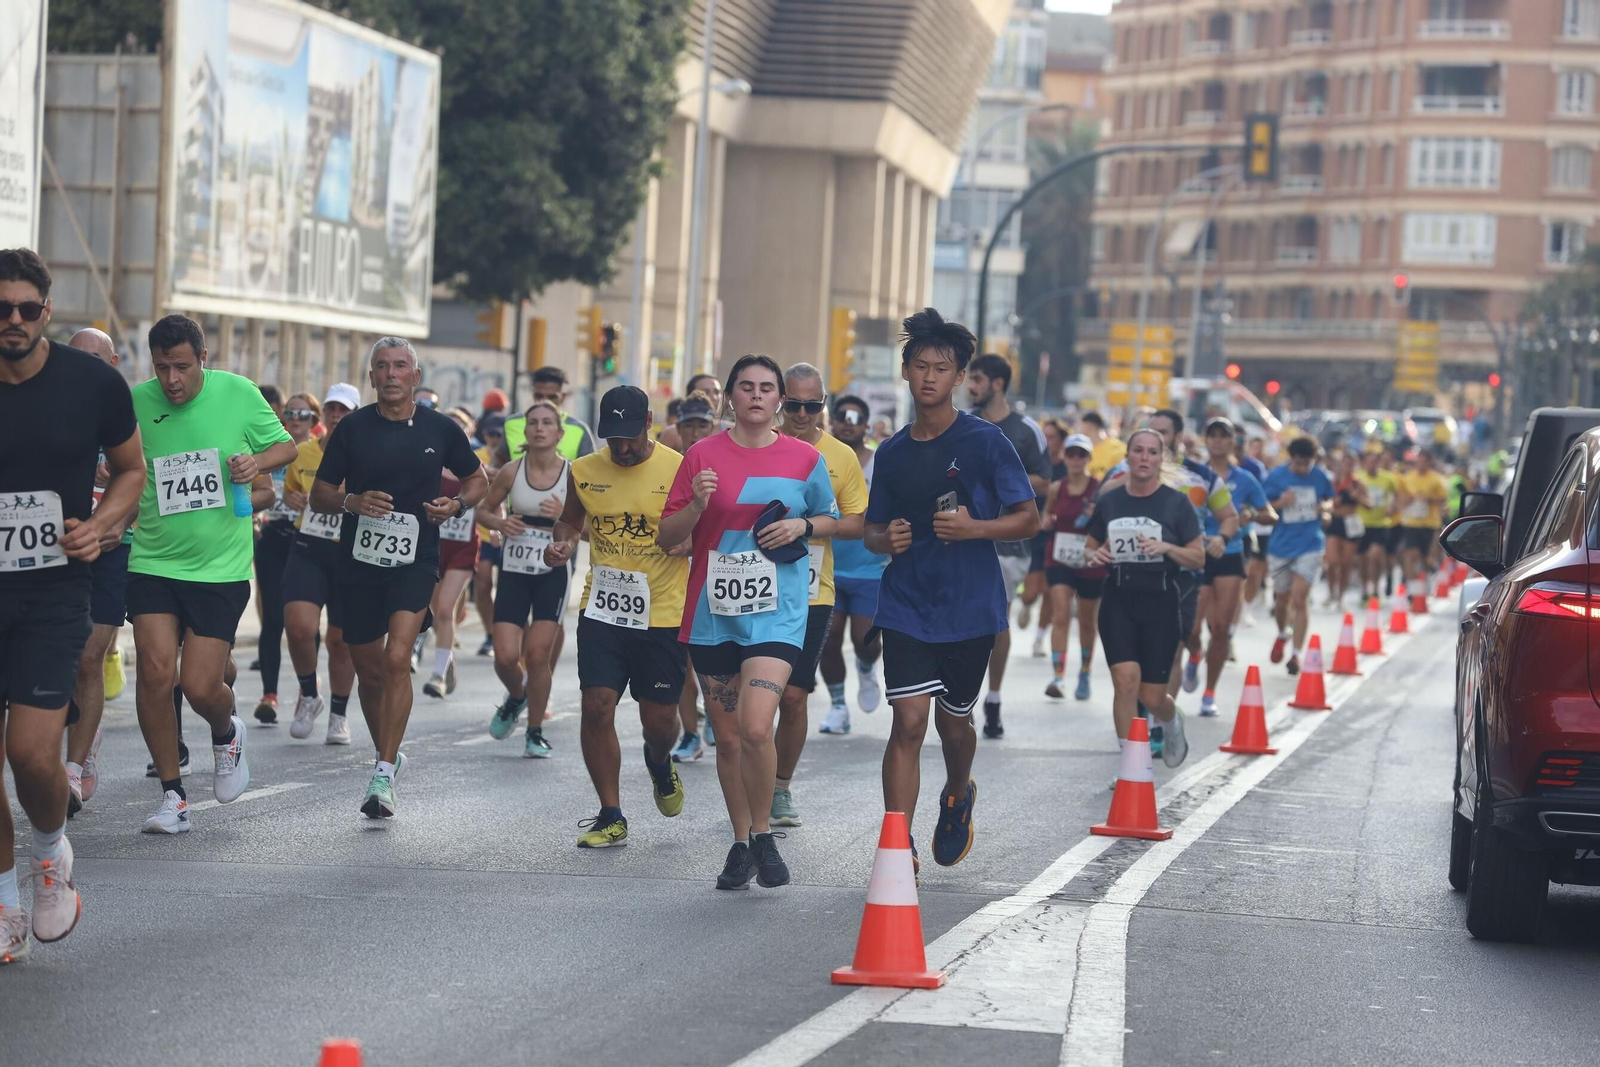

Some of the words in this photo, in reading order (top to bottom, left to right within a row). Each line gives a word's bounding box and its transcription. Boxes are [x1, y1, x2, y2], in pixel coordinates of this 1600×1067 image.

[162, 473, 219, 500] 7446
[308, 513, 343, 529] 740
[0, 522, 58, 552] 708
[360, 529, 412, 556] 8733
[714, 576, 773, 600] 5052
[595, 589, 646, 615] 5639
